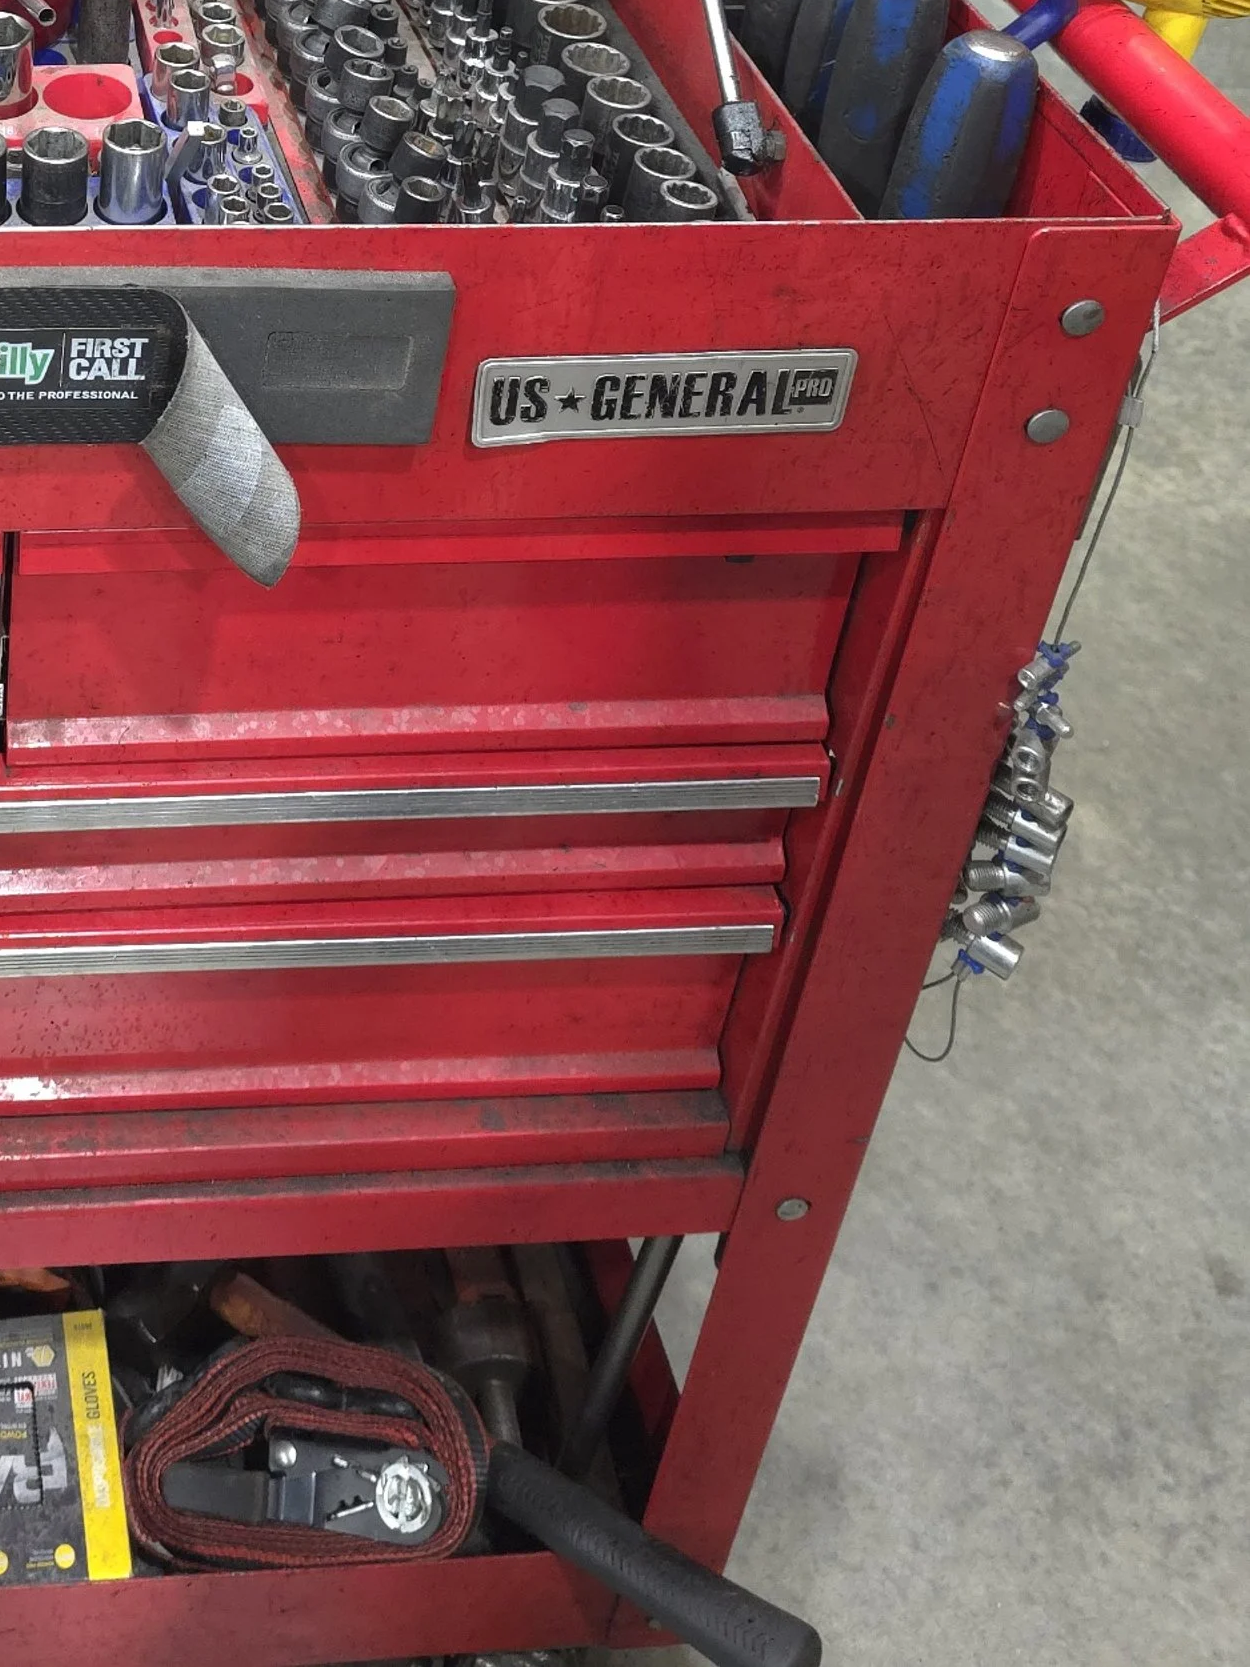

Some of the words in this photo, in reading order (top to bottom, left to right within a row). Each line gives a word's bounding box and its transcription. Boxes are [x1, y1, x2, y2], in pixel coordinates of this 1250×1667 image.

[70, 337, 149, 359] FIRST
[68, 358, 146, 381] CALL
[7, 390, 34, 401] THE
[38, 390, 139, 401] PROFESSIONAL
[488, 375, 550, 425] US
[590, 368, 792, 421] GENERAL
[792, 376, 833, 399] PRO
[85, 1369, 101, 1420] GLOVES
